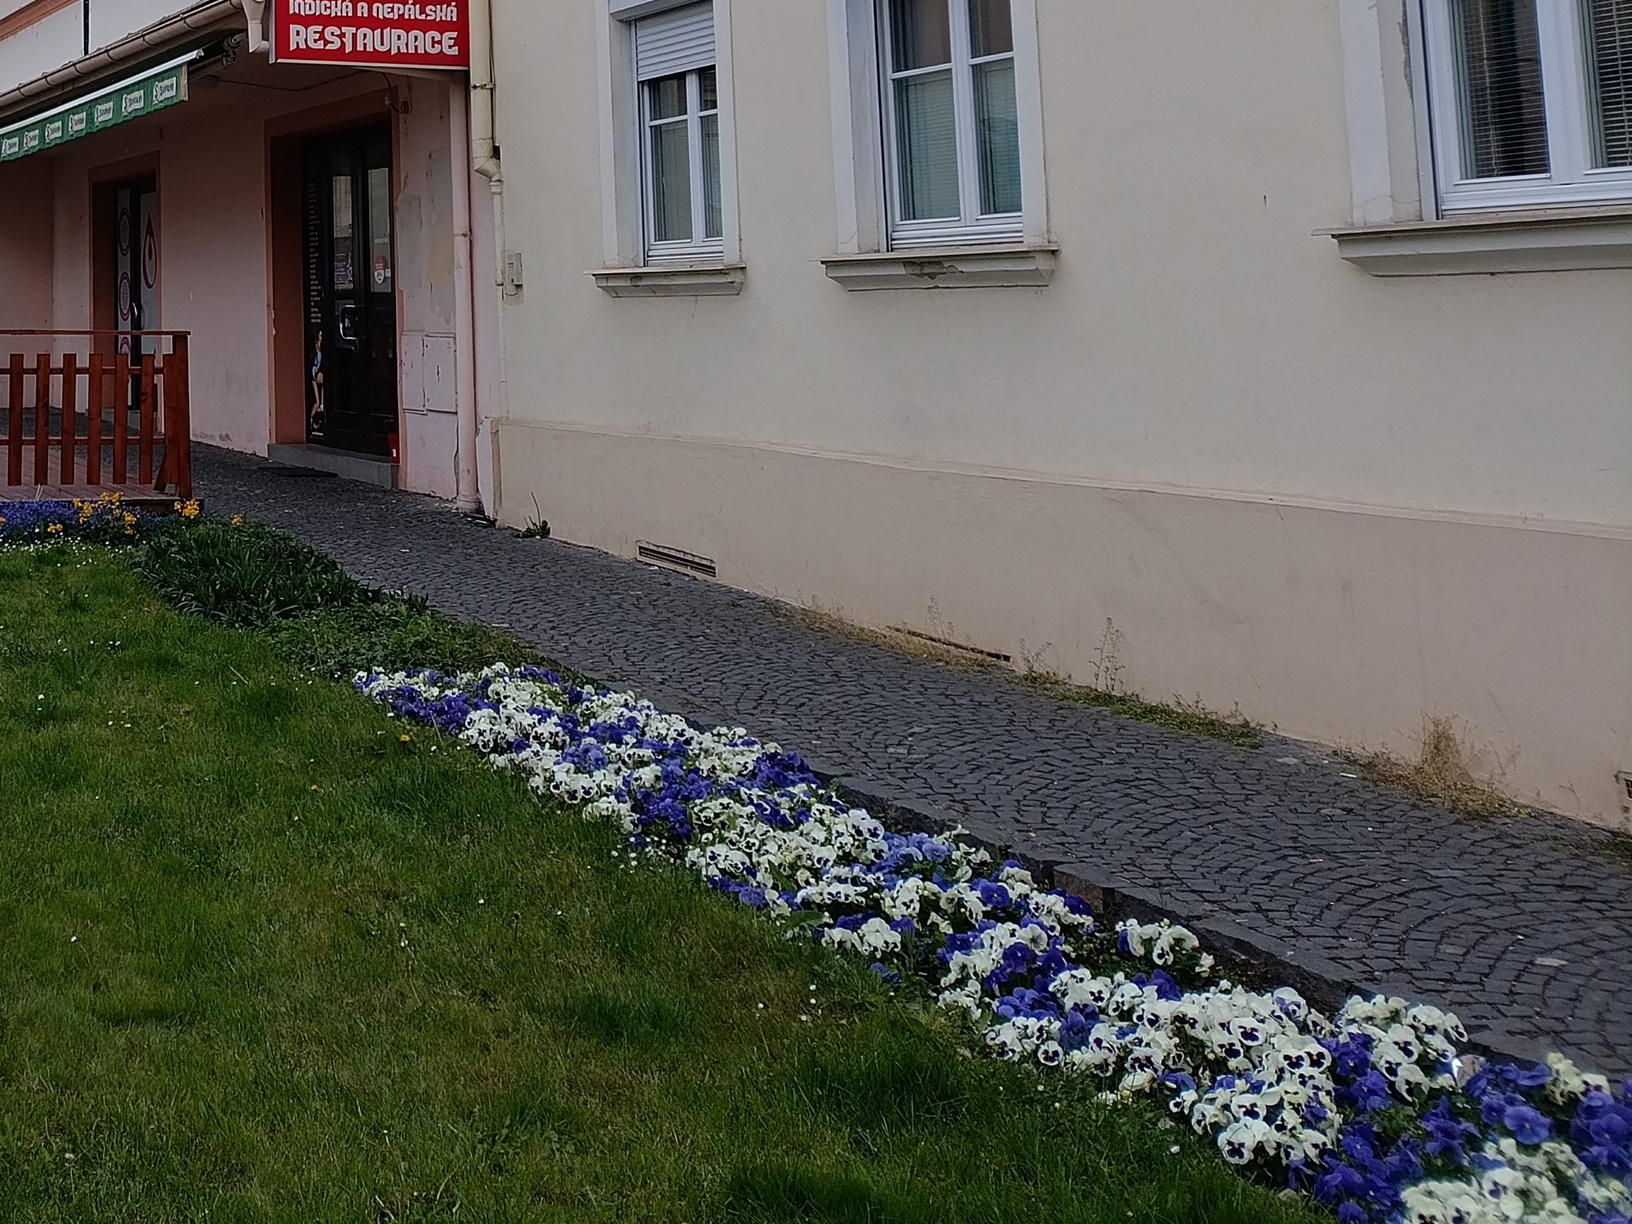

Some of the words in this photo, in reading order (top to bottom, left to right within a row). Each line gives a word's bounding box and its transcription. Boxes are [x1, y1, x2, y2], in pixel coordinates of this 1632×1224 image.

[356, 1, 369, 17] A
[371, 0, 458, 22] NEPÁLSKÁ
[288, 24, 460, 56] RESTAURACE
